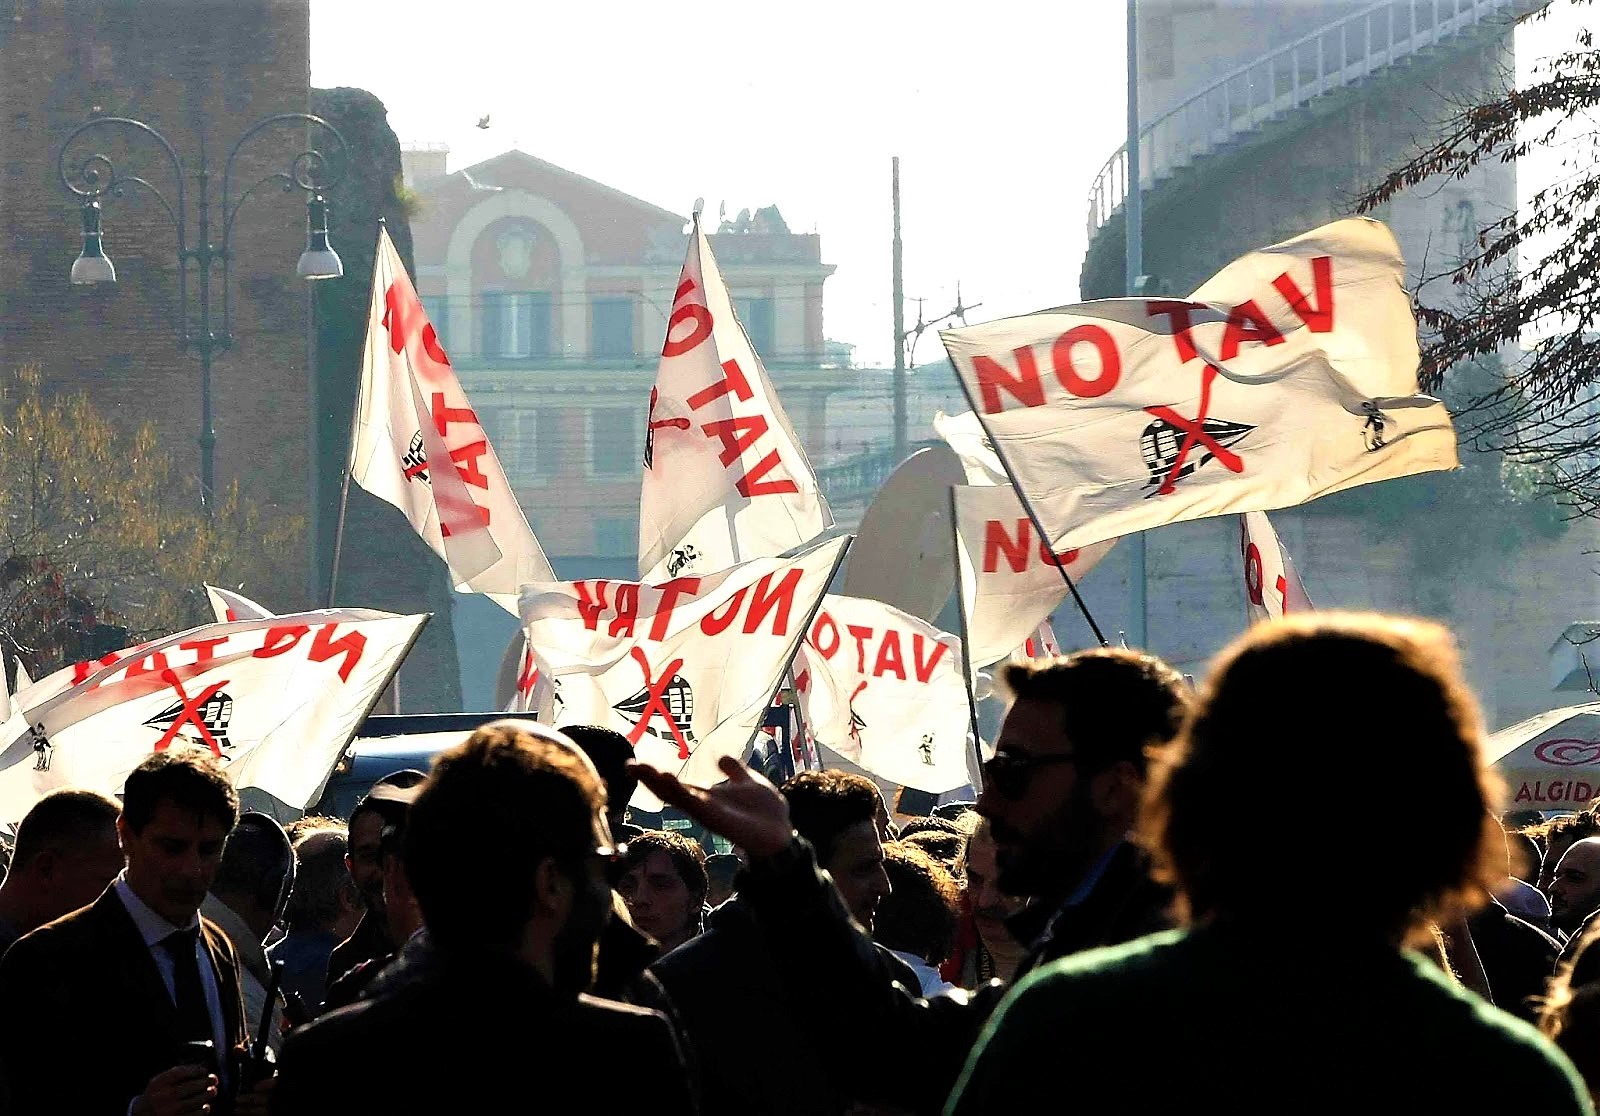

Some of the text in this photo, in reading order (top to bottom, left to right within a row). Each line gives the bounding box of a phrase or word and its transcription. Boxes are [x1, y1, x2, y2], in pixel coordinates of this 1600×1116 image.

[970, 256, 1334, 414] NO TAV
[686, 358, 799, 497] TAV
[847, 624, 949, 684] TAV
